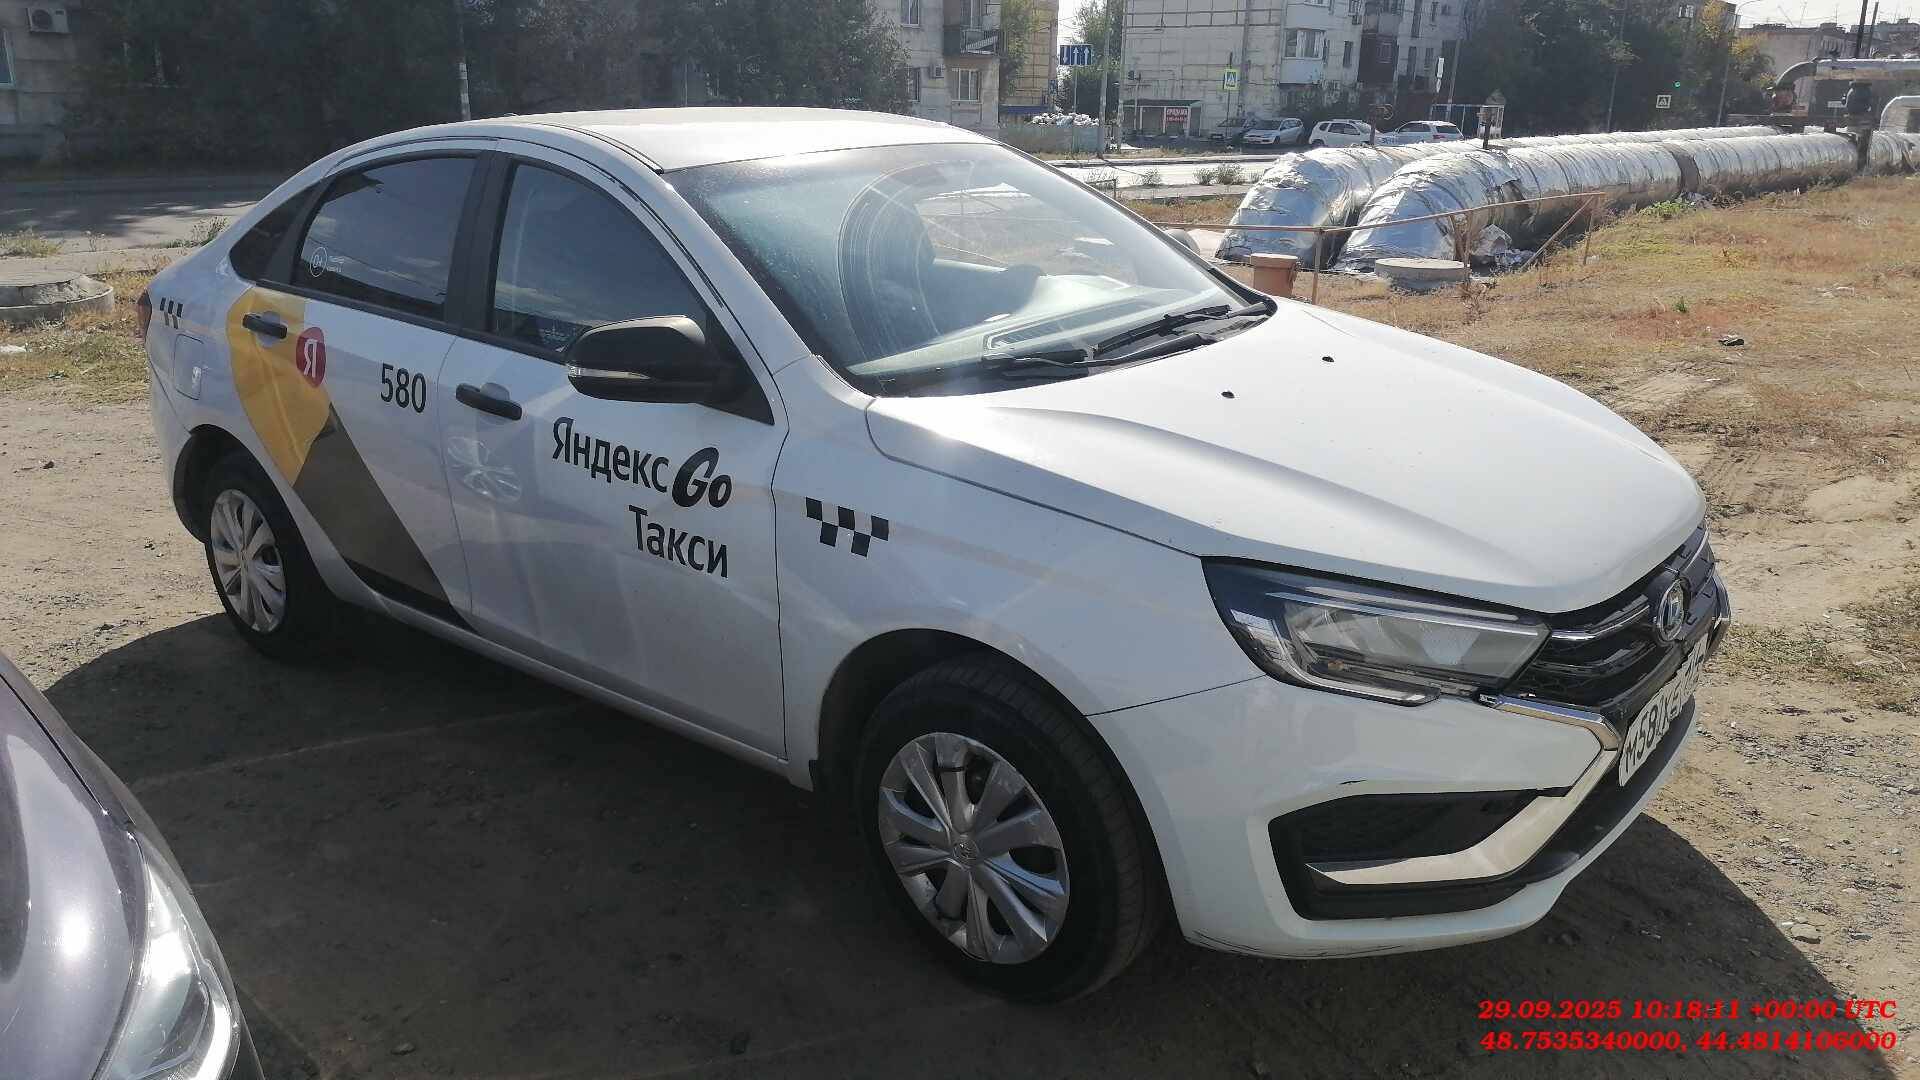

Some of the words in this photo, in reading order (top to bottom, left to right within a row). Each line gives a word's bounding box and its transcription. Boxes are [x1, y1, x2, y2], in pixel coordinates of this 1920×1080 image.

[304, 340, 319, 378] Я
[380, 363, 427, 413] 580
[552, 416, 670, 493] Яндекс
[672, 446, 733, 508] Go
[628, 505, 728, 578] Такси
